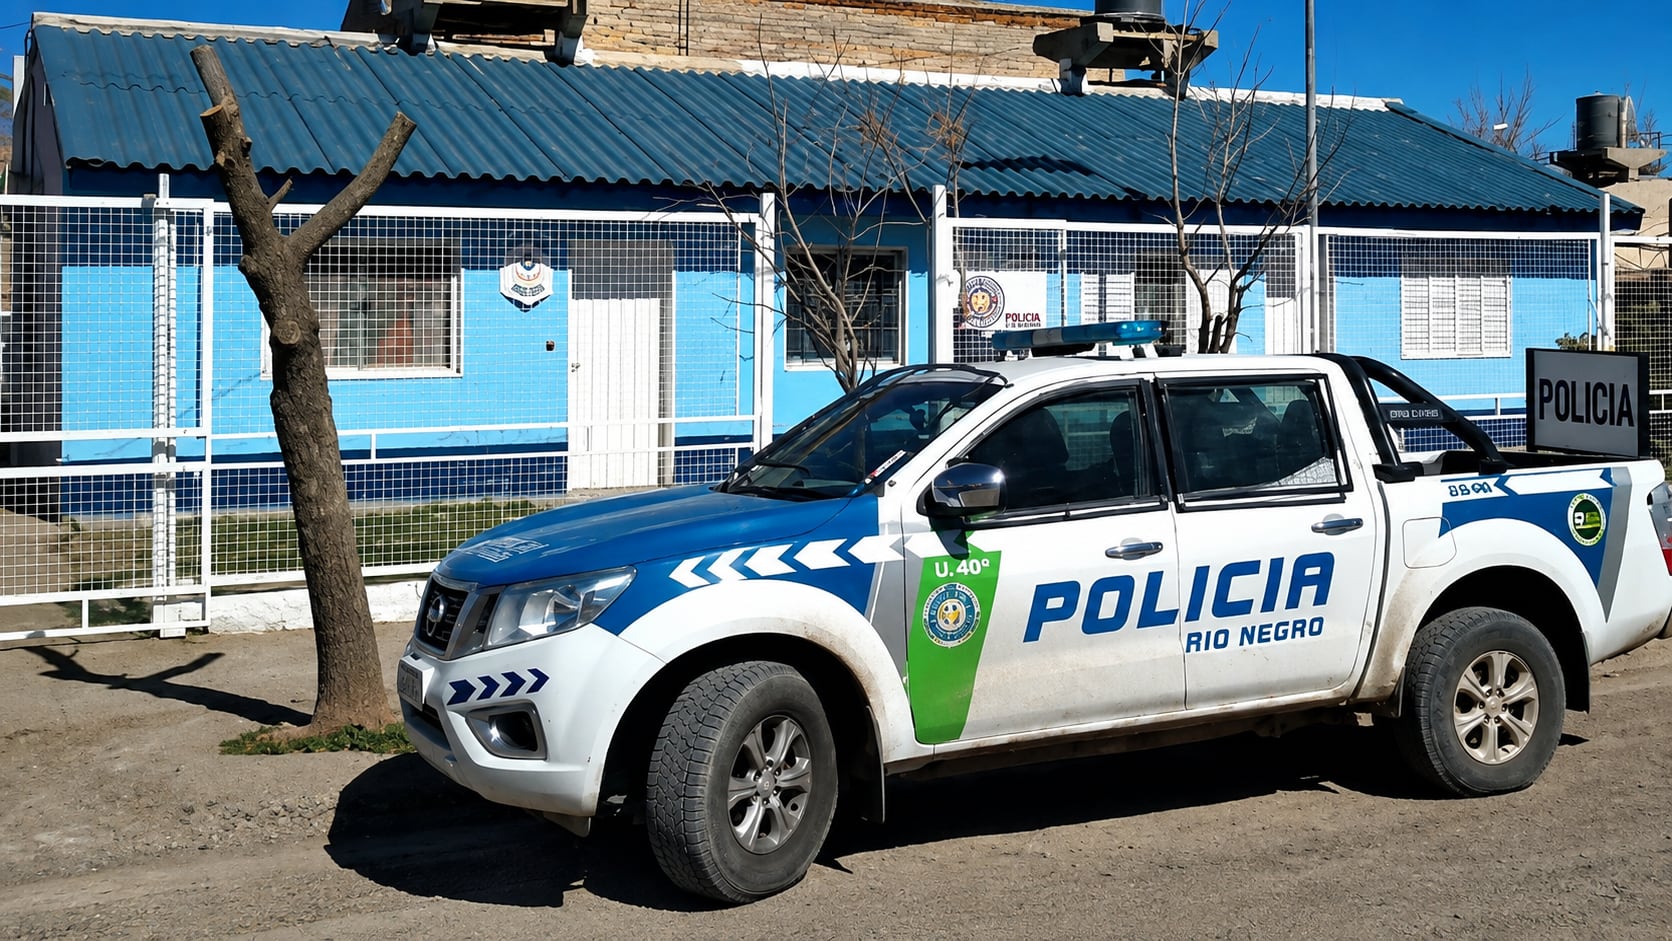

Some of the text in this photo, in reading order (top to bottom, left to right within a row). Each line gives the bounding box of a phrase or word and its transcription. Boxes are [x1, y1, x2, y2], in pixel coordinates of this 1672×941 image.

[1005, 312, 1041, 323] POLICIA
[1538, 378, 1635, 428] POLICIA
[1022, 551, 1335, 643] POLICIA
[1185, 616, 1325, 653] RIO NEGRO
